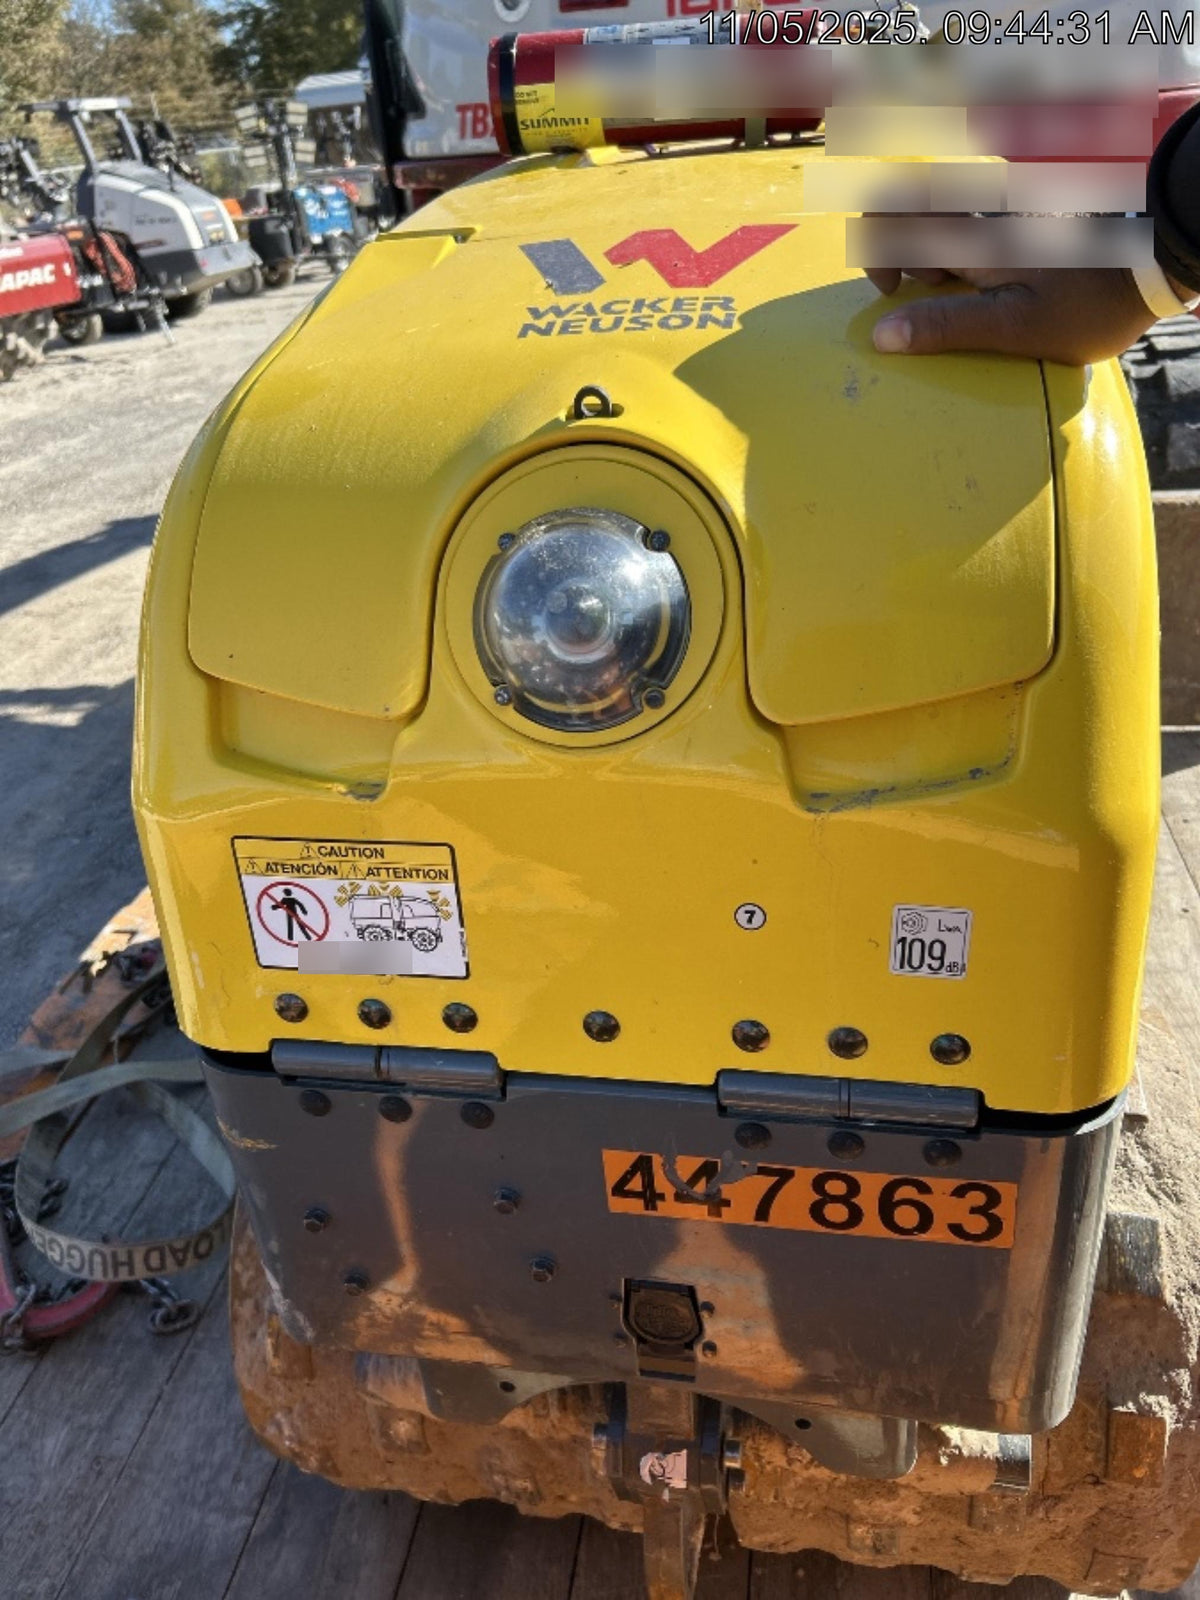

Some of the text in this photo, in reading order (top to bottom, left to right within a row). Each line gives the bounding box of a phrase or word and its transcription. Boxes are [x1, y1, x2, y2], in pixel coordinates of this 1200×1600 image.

[455, 103, 496, 140] TB
[526, 296, 738, 321] WACKER
[517, 312, 737, 339] NEUSON
[317, 845, 385, 859] CAUTION
[264, 861, 338, 876] ATENCIÓN
[365, 866, 449, 881] ATTENTION
[744, 909, 756, 925] 7
[897, 936, 947, 971] 109
[611, 1153, 1004, 1243] 447863
